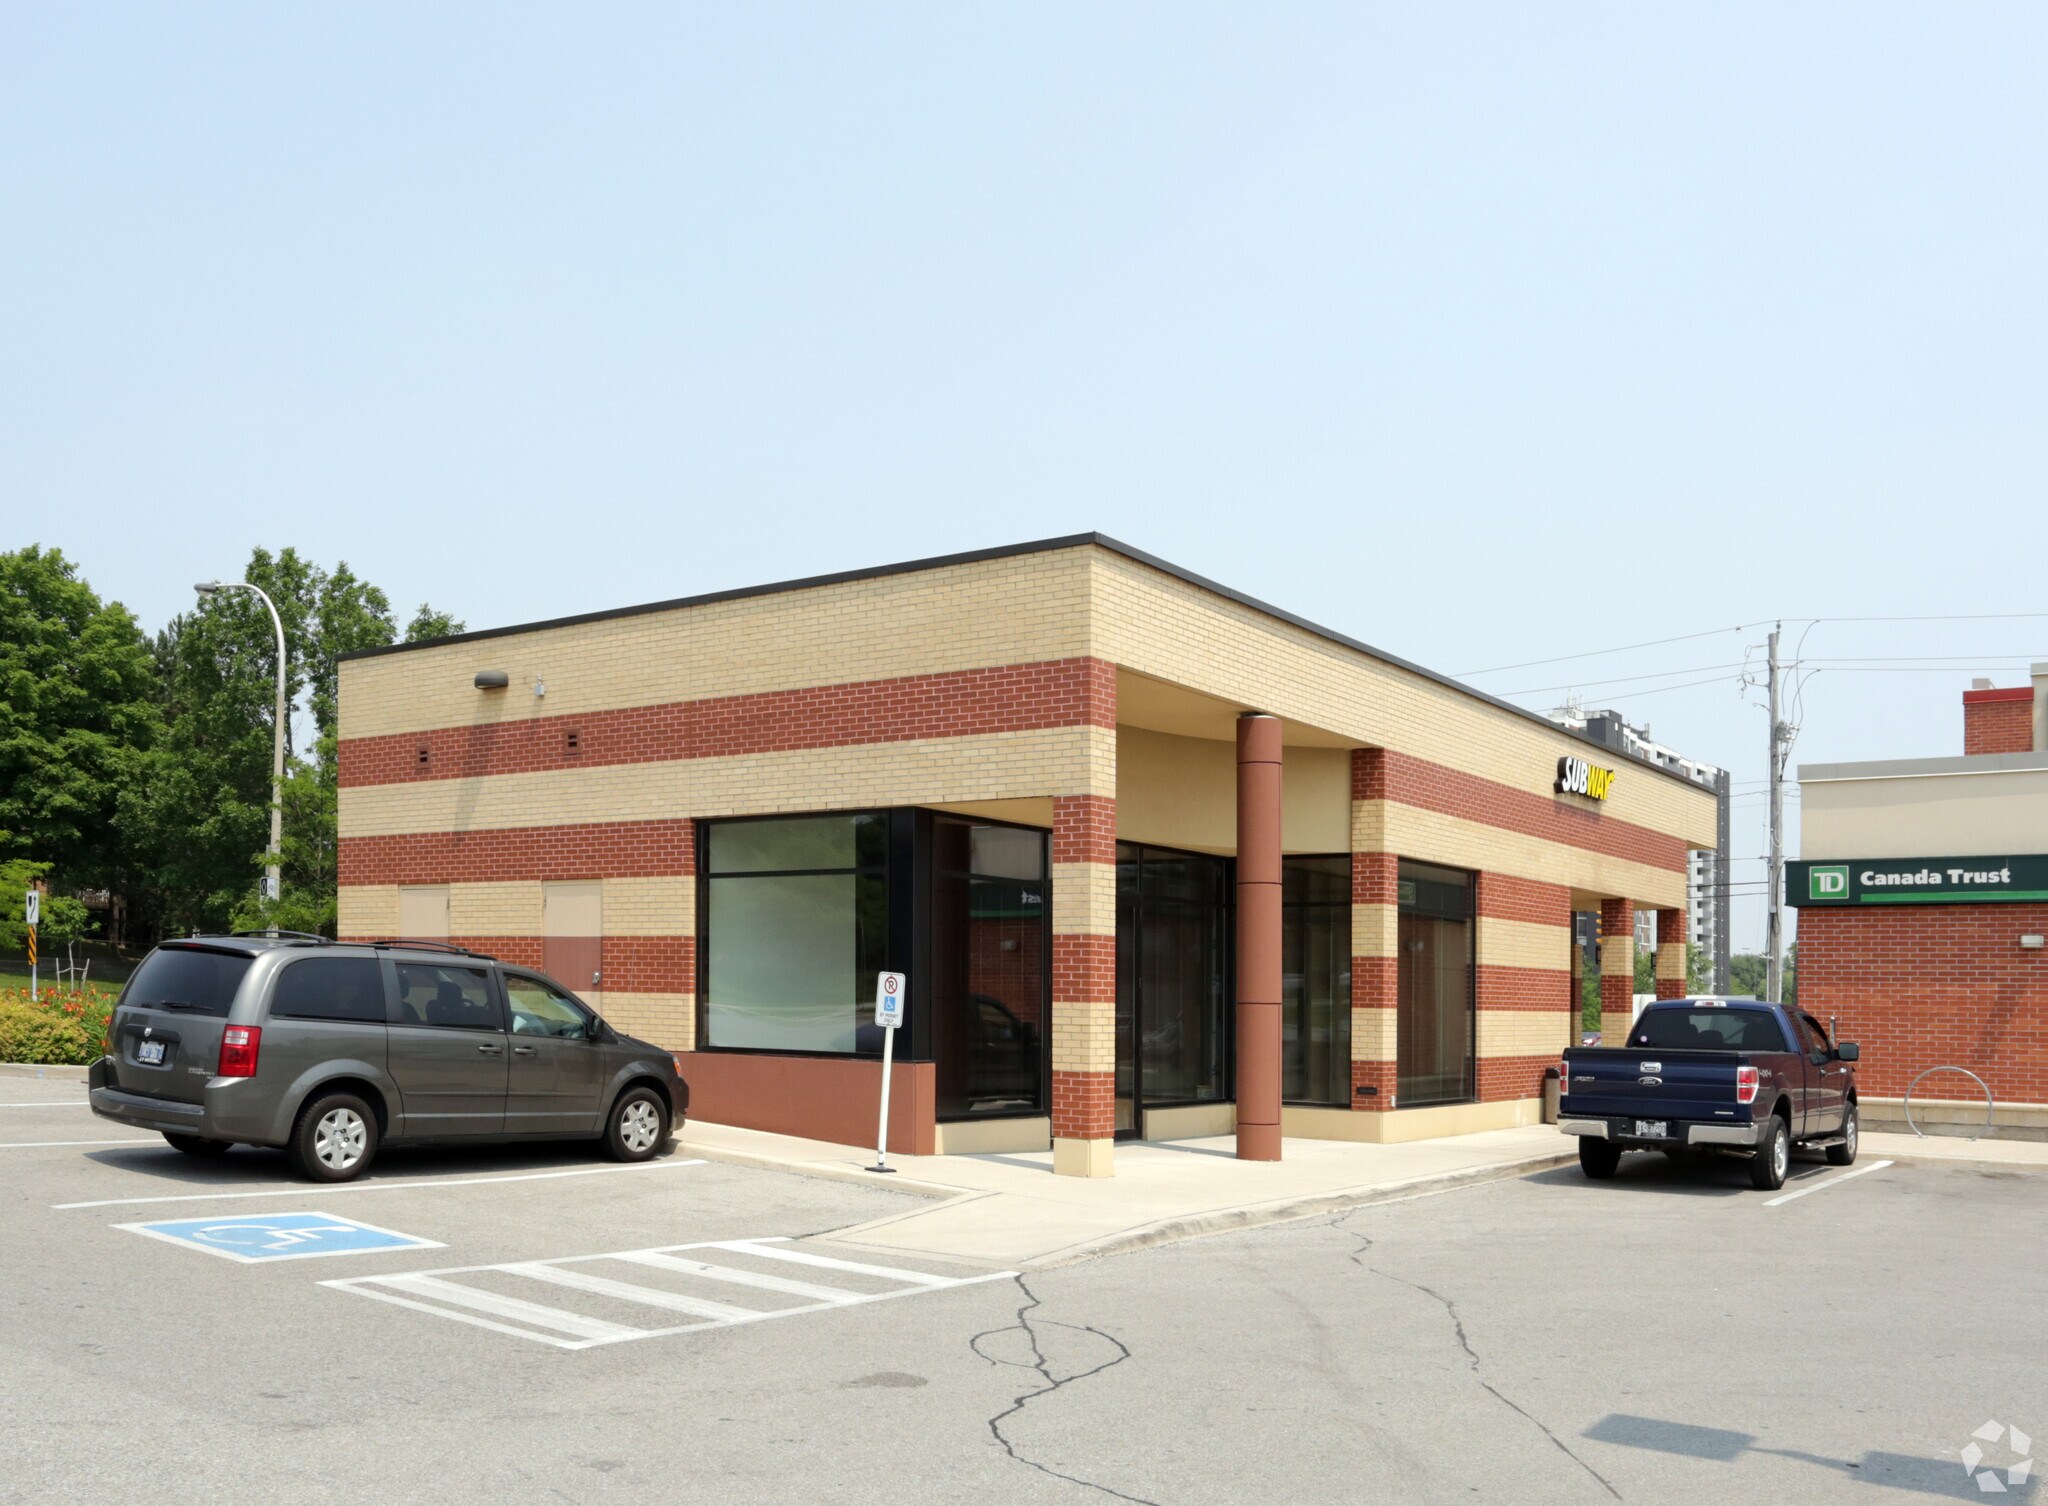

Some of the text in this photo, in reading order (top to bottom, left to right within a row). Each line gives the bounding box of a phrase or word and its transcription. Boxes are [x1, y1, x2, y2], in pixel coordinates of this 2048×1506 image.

[1562, 756, 1615, 801] SUBWAY
[1814, 868, 2011, 893] TD Canada Trust
